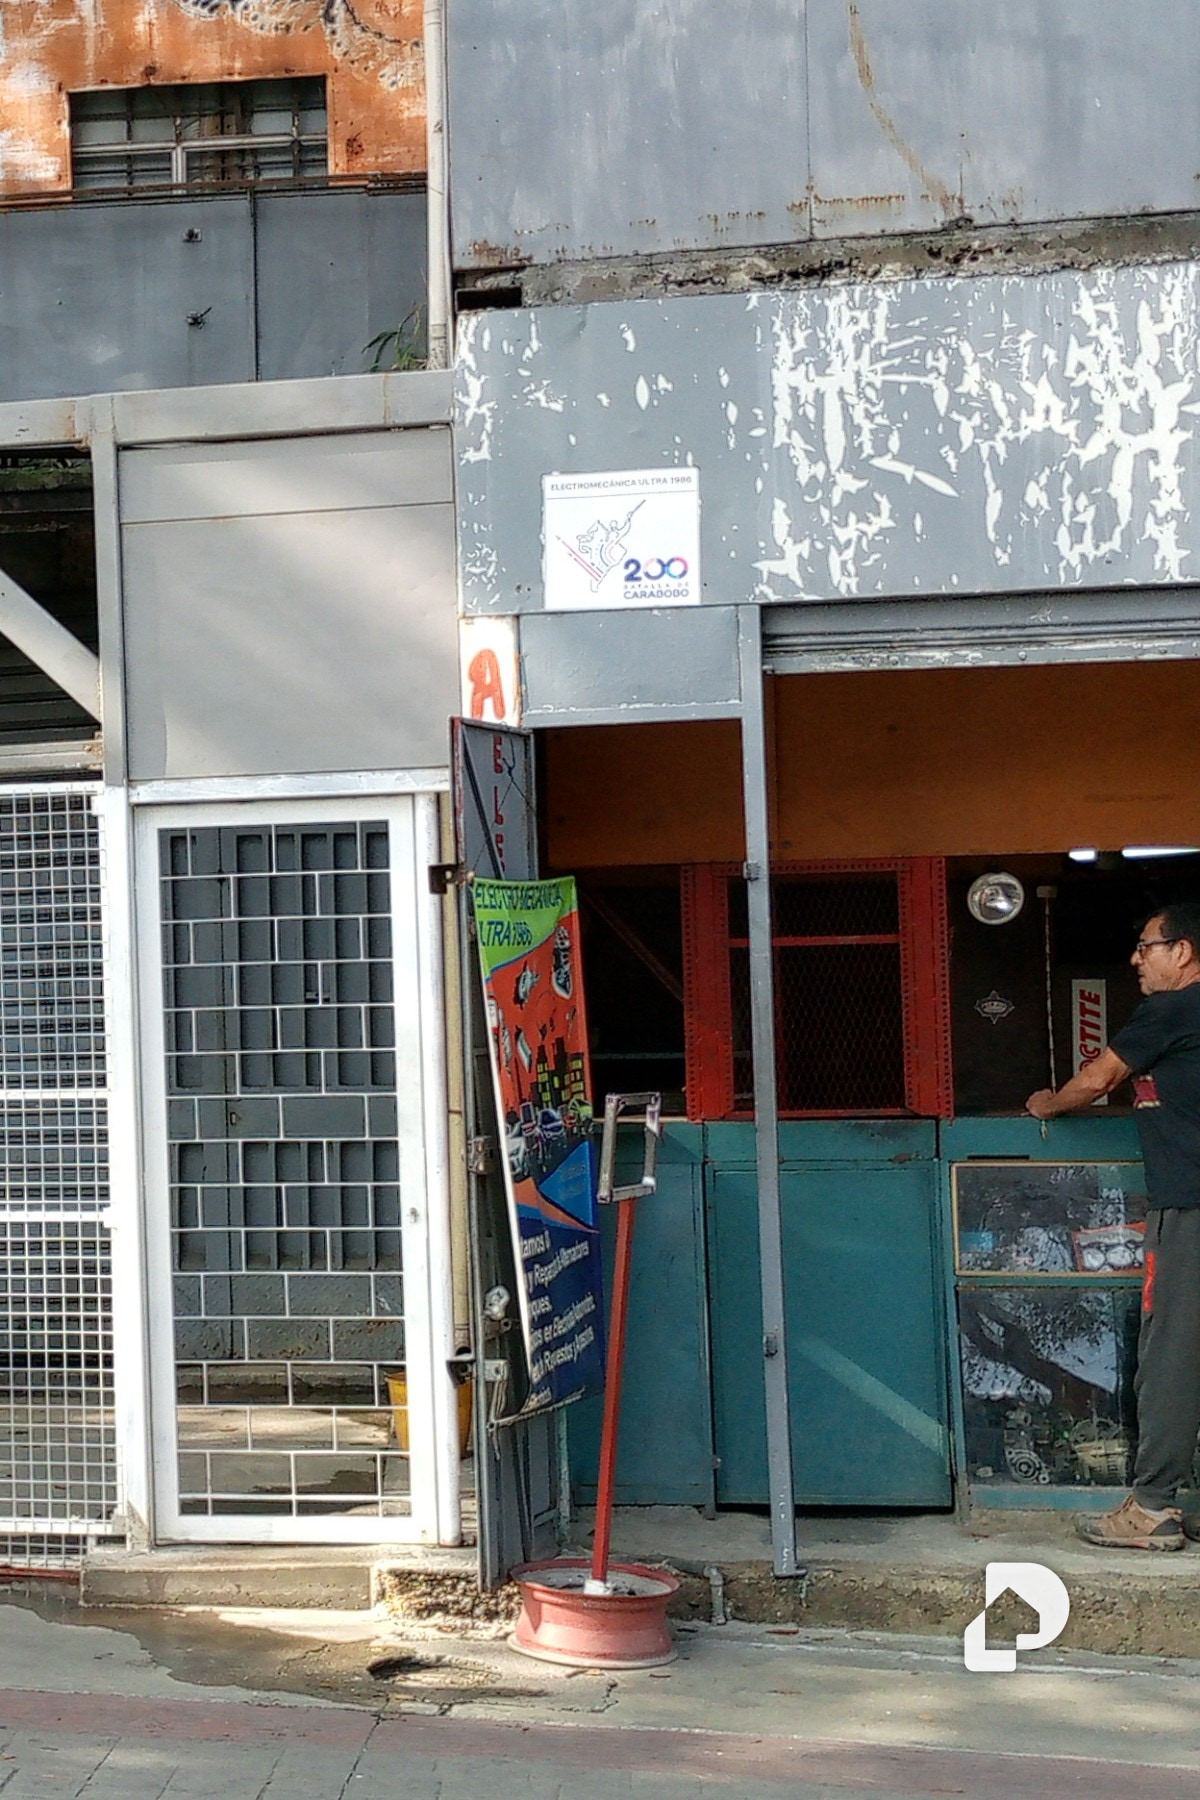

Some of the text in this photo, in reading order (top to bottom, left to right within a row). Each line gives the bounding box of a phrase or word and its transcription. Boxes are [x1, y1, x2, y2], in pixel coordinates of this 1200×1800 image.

[638, 477, 668, 486] ULTRA
[670, 476, 692, 485] 1986
[623, 556, 689, 583] 200
[623, 588, 689, 600] CARABOBO
[479, 921, 511, 946] LTRA
[1079, 988, 1102, 1072] CTITE
